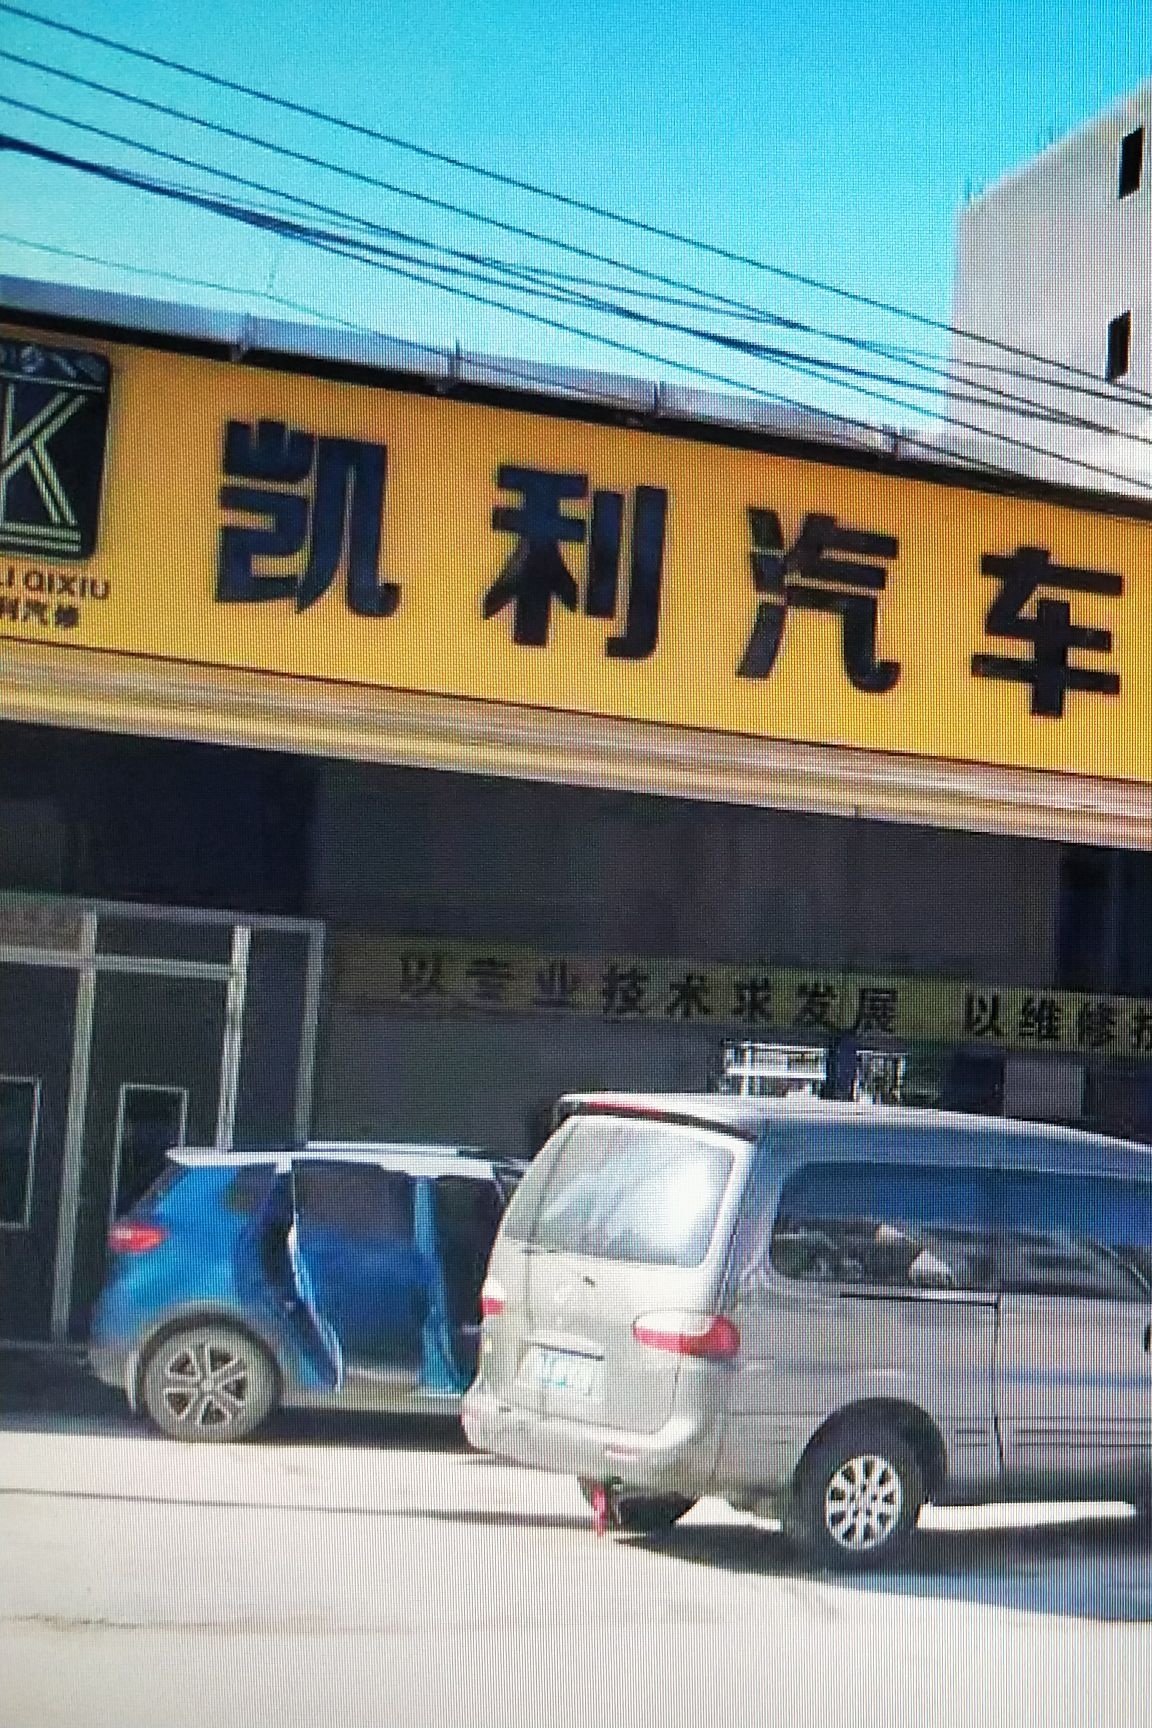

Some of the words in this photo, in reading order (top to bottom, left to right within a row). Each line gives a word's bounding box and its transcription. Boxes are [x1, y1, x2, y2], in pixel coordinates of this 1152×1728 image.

[398, 948, 899, 1037] 以专业技术求发展
